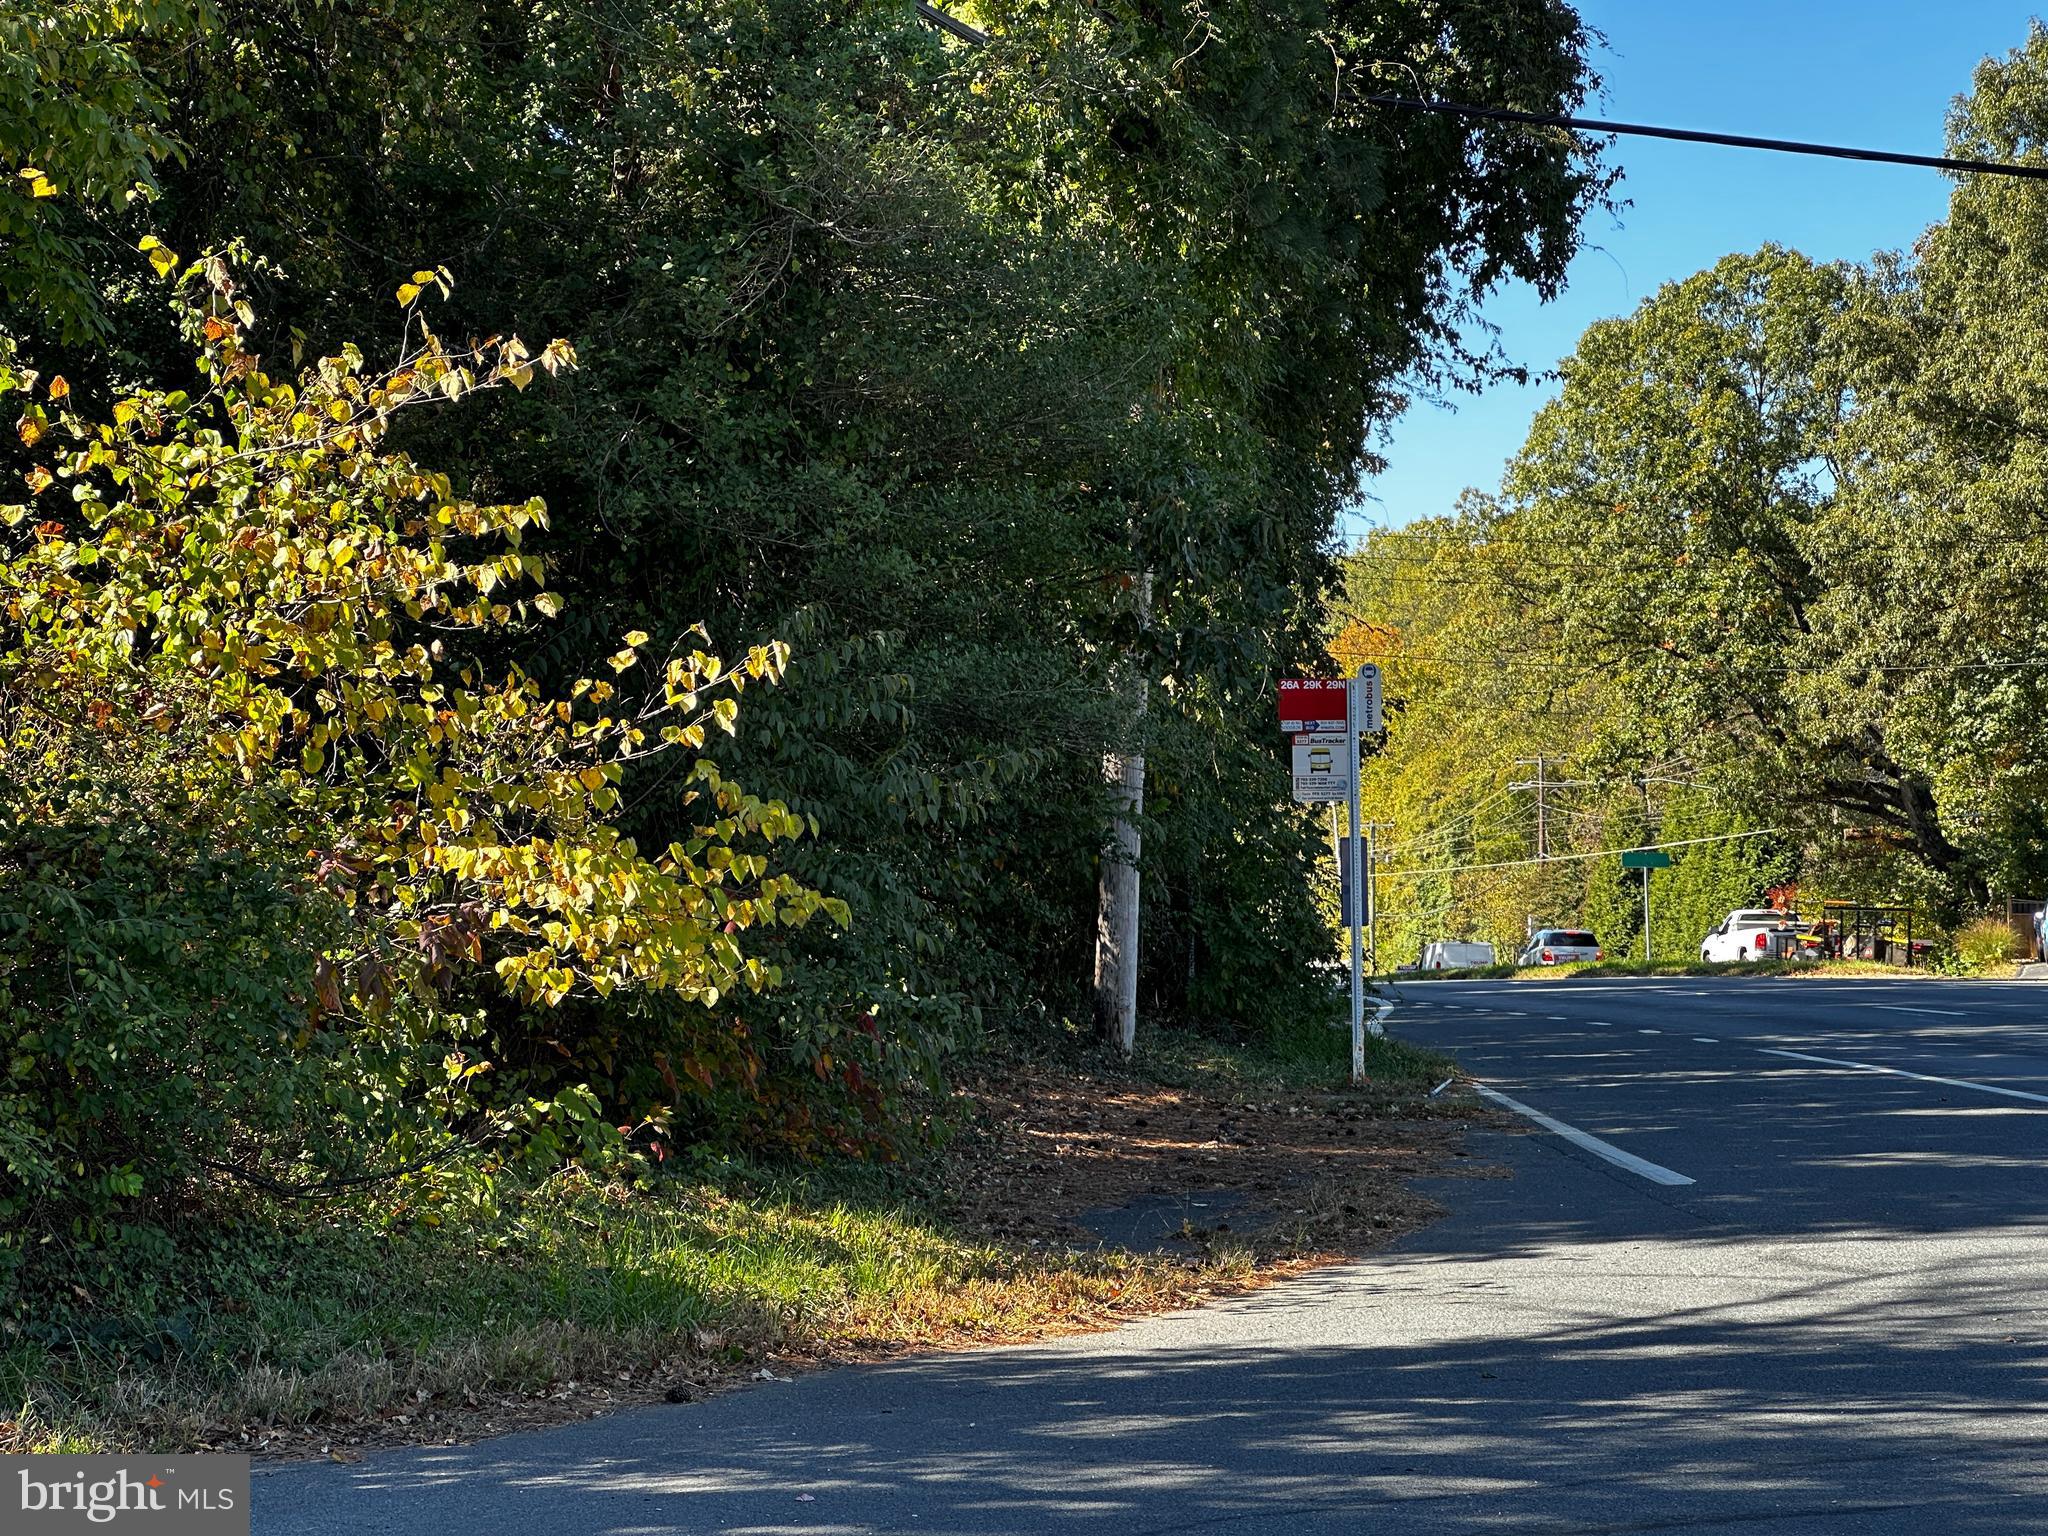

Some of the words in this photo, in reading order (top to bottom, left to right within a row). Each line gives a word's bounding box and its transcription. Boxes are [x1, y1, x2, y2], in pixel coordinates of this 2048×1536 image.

[1280, 680, 1300, 689] 26A
[1303, 680, 1322, 689] 29K
[1326, 680, 1345, 689] 29N
[1365, 680, 1373, 729] metrobus
